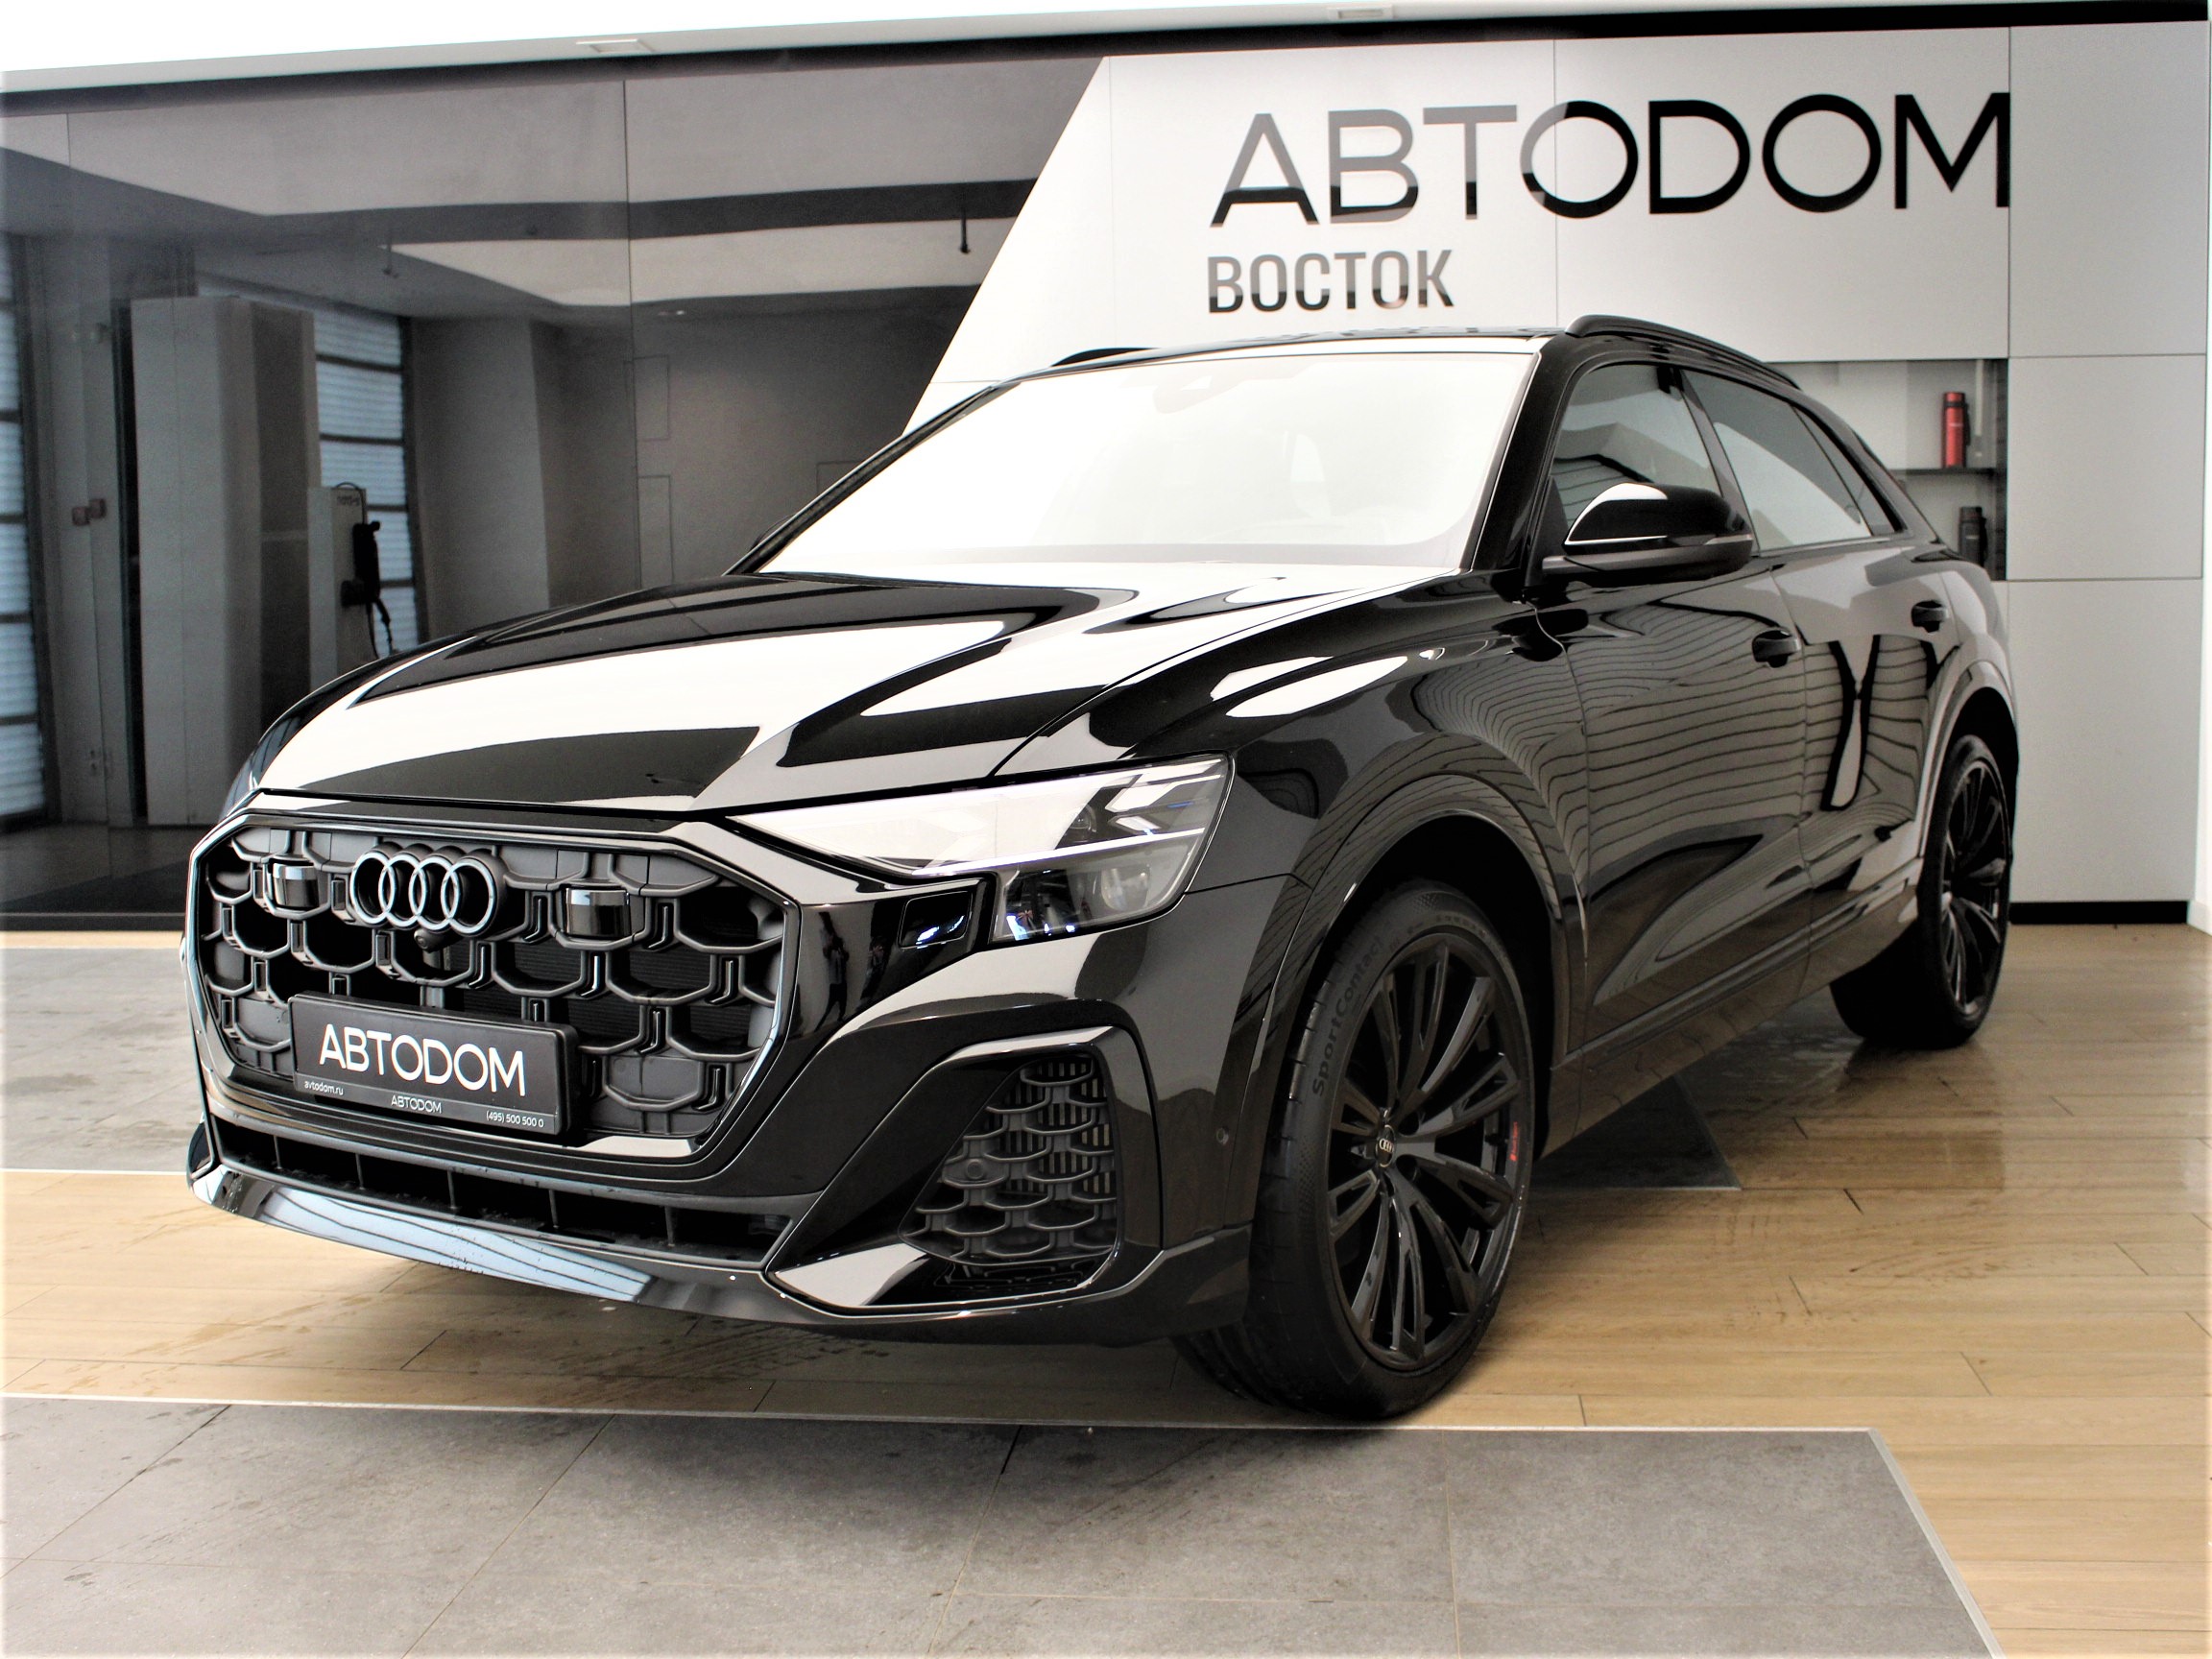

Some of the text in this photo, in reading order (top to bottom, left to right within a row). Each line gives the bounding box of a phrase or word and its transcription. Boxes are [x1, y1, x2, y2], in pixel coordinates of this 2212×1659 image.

[303, 1080, 344, 1095] avtodom.ru
[486, 1110, 544, 1128] (495) 500 500 0
